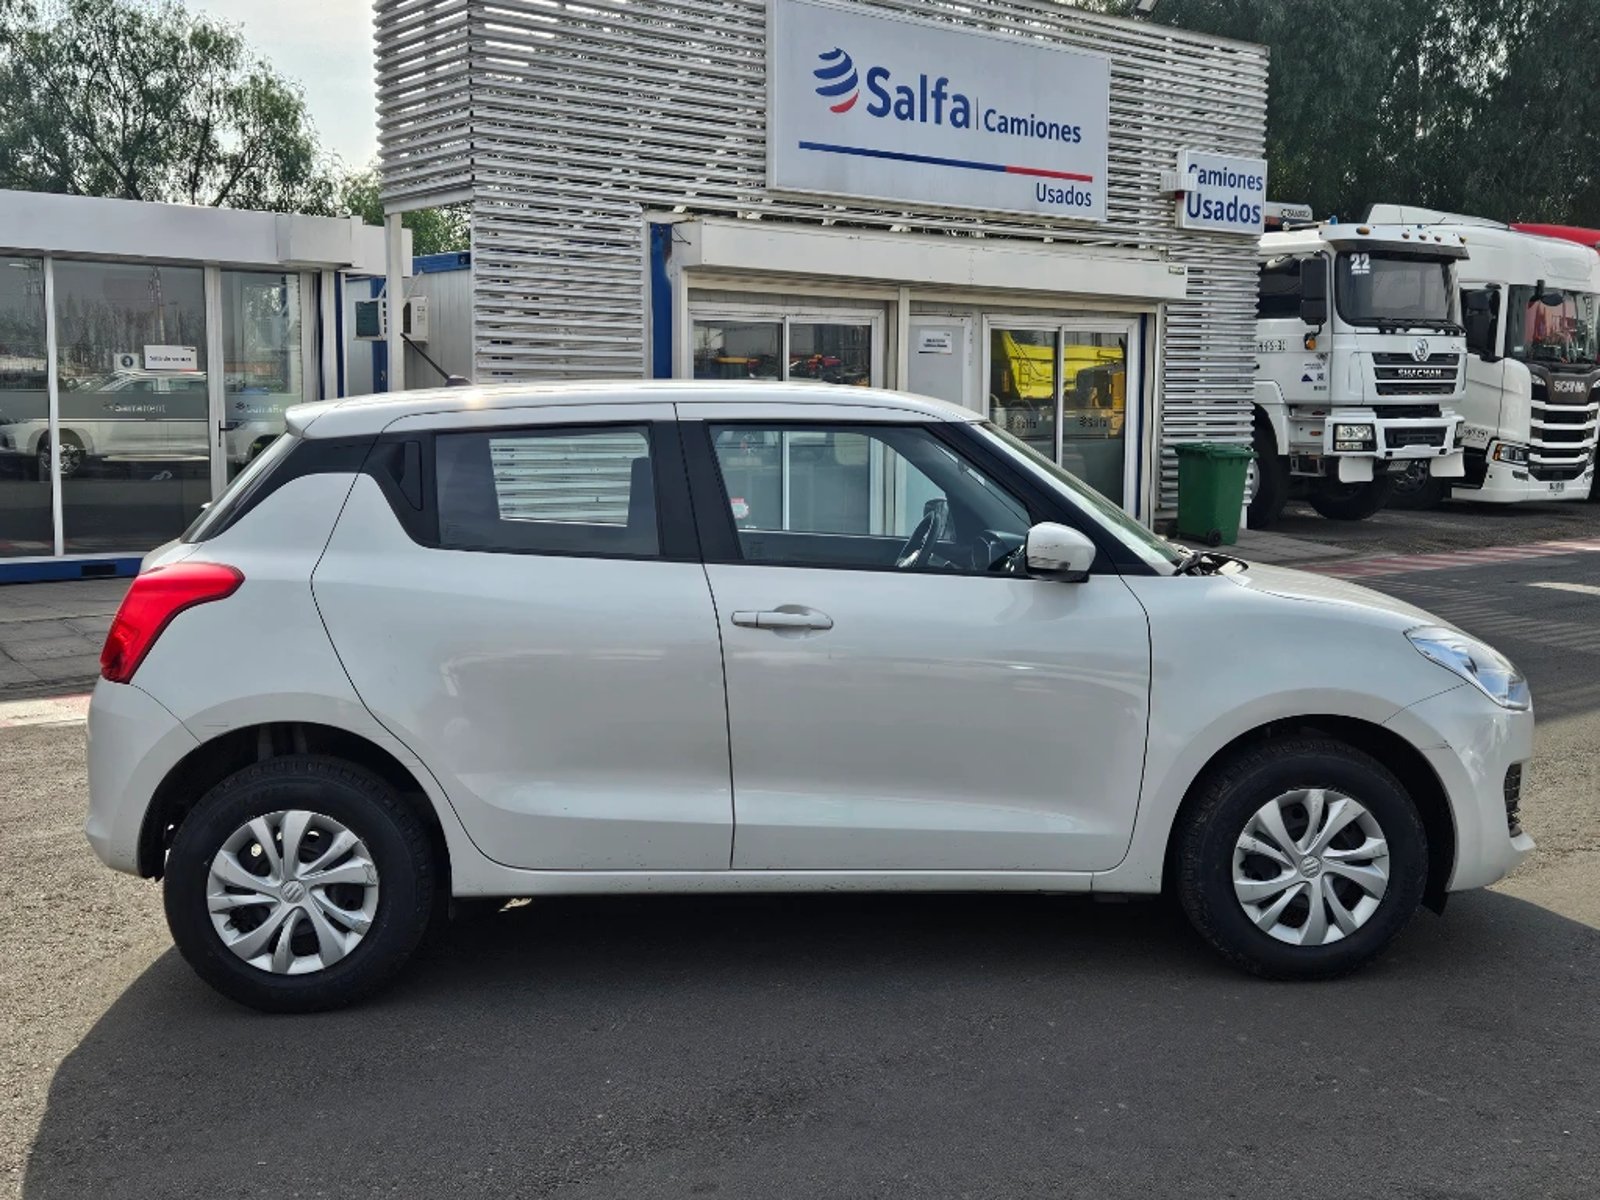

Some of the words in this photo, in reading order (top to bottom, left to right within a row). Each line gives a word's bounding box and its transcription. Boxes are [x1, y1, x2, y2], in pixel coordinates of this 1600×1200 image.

[866, 66, 970, 129] Salfa
[984, 108, 1081, 143] Camiones
[1036, 182, 1092, 207] Usados
[1187, 190, 1261, 224] Usados
[1350, 253, 1370, 270] 22
